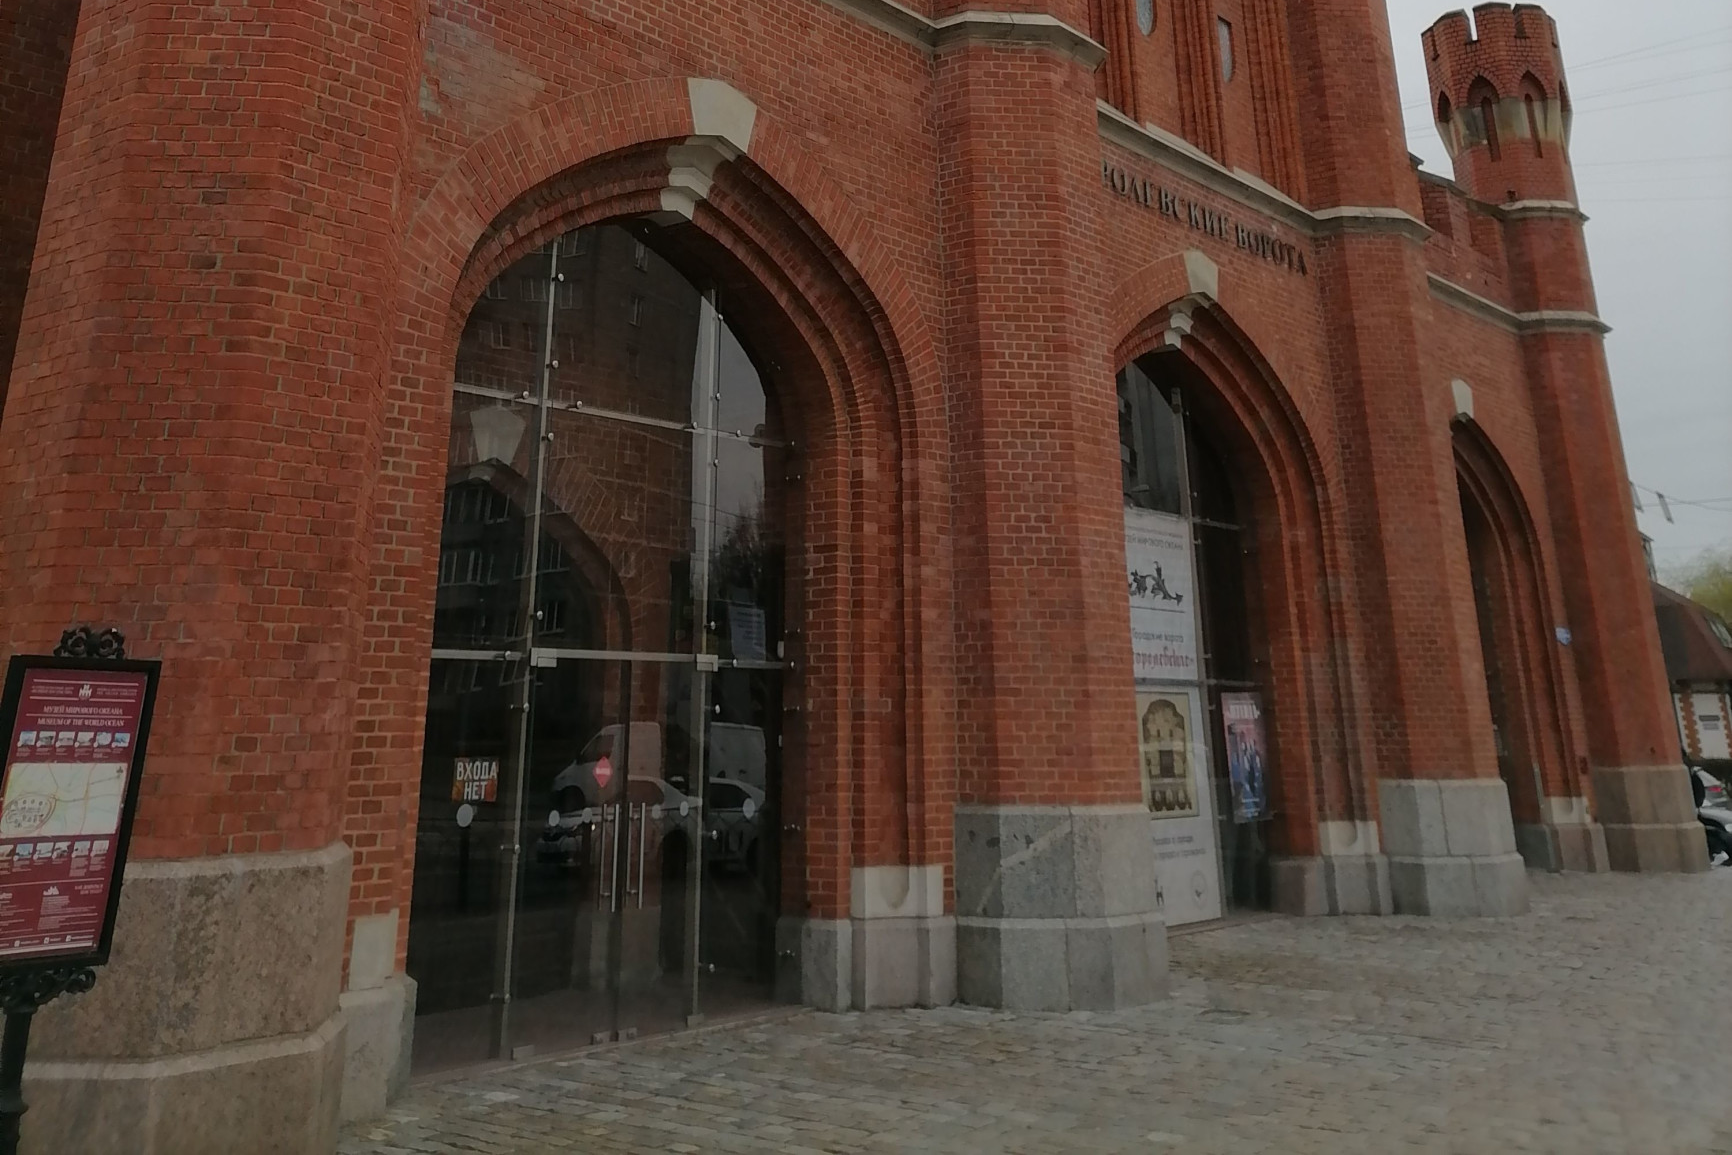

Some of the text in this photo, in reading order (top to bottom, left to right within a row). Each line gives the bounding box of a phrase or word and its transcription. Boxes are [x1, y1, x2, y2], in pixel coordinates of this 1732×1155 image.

[1235, 223, 1309, 277] ВОРОТА
[43, 705, 123, 715] МУЗЕЙ МИРОВОГО ОКЕАНА
[37, 717, 125, 727] MUSEUM OF THE WORLD OCEAN
[456, 761, 498, 780] ВХОДА
[463, 781, 487, 800] НЕТ
